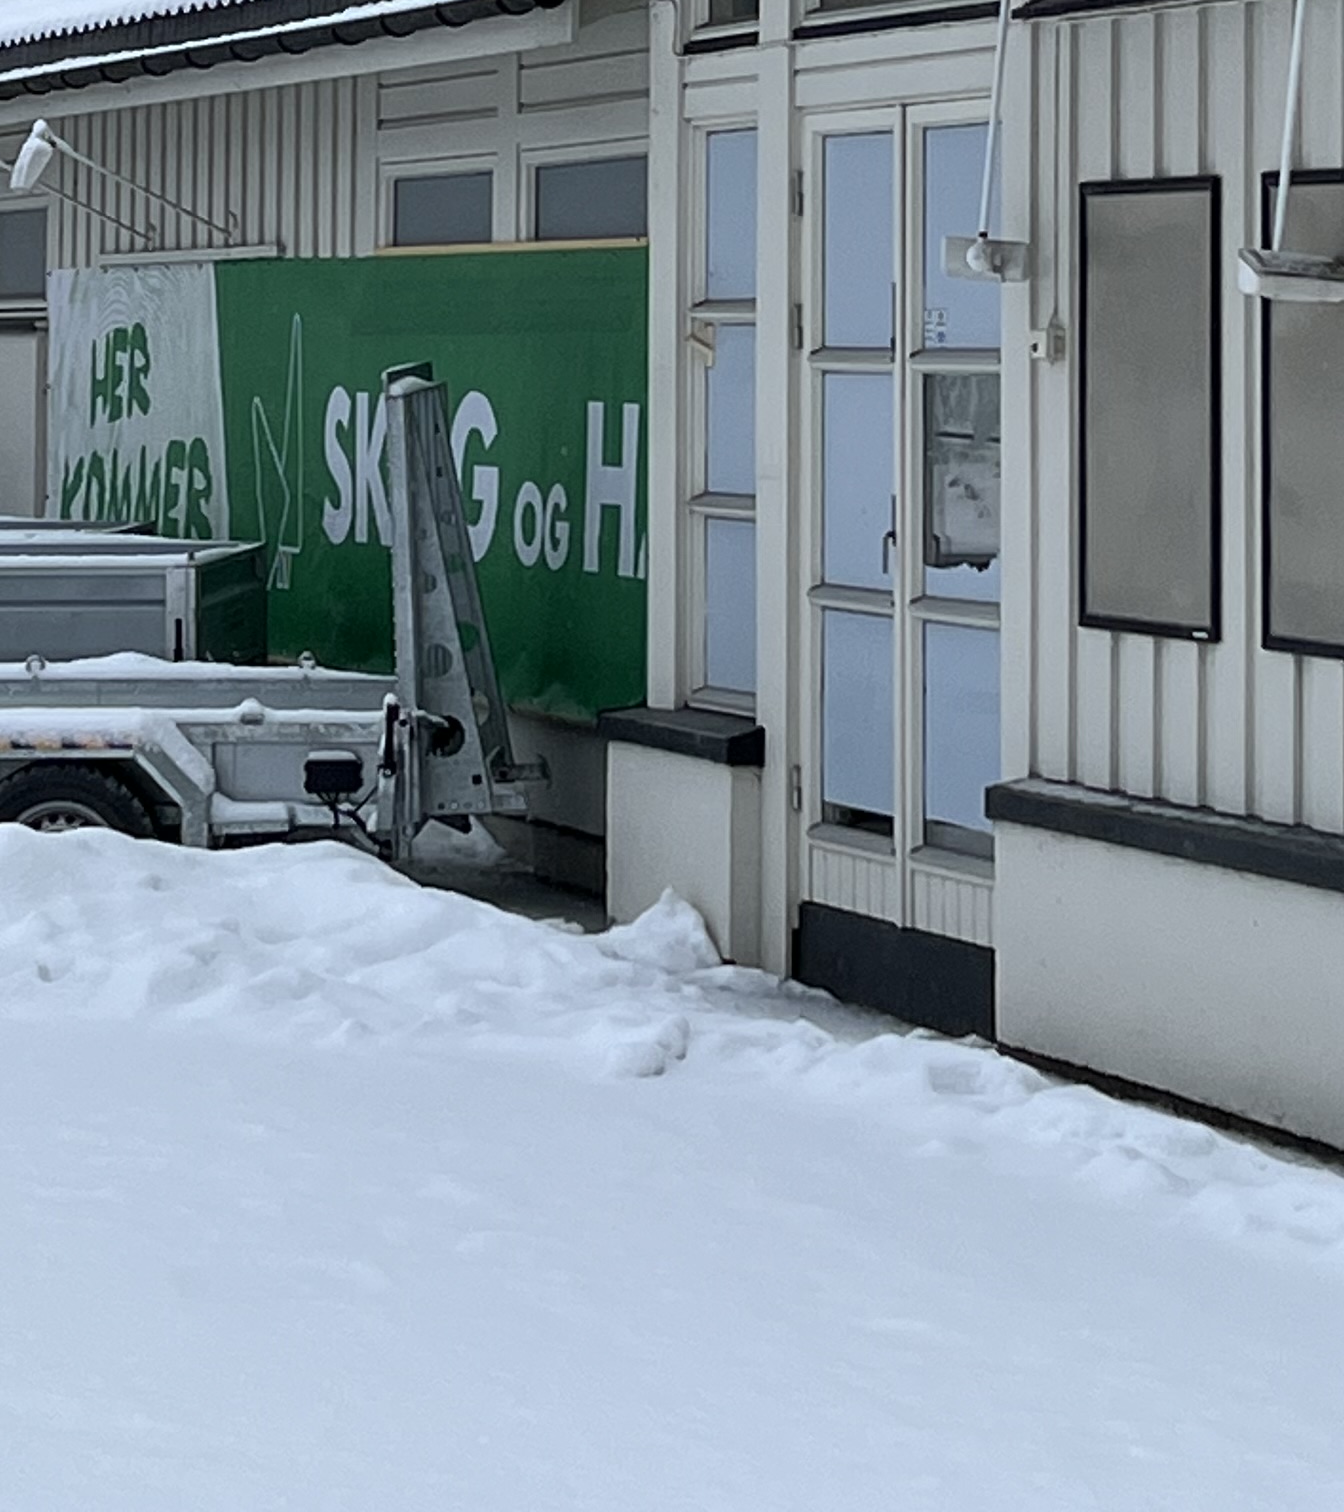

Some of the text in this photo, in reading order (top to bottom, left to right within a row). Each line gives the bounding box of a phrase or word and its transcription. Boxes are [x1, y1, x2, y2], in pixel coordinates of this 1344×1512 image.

[90, 321, 151, 429] HER
[60, 437, 213, 540] KOMMER
[322, 385, 647, 580] SKG OG H
